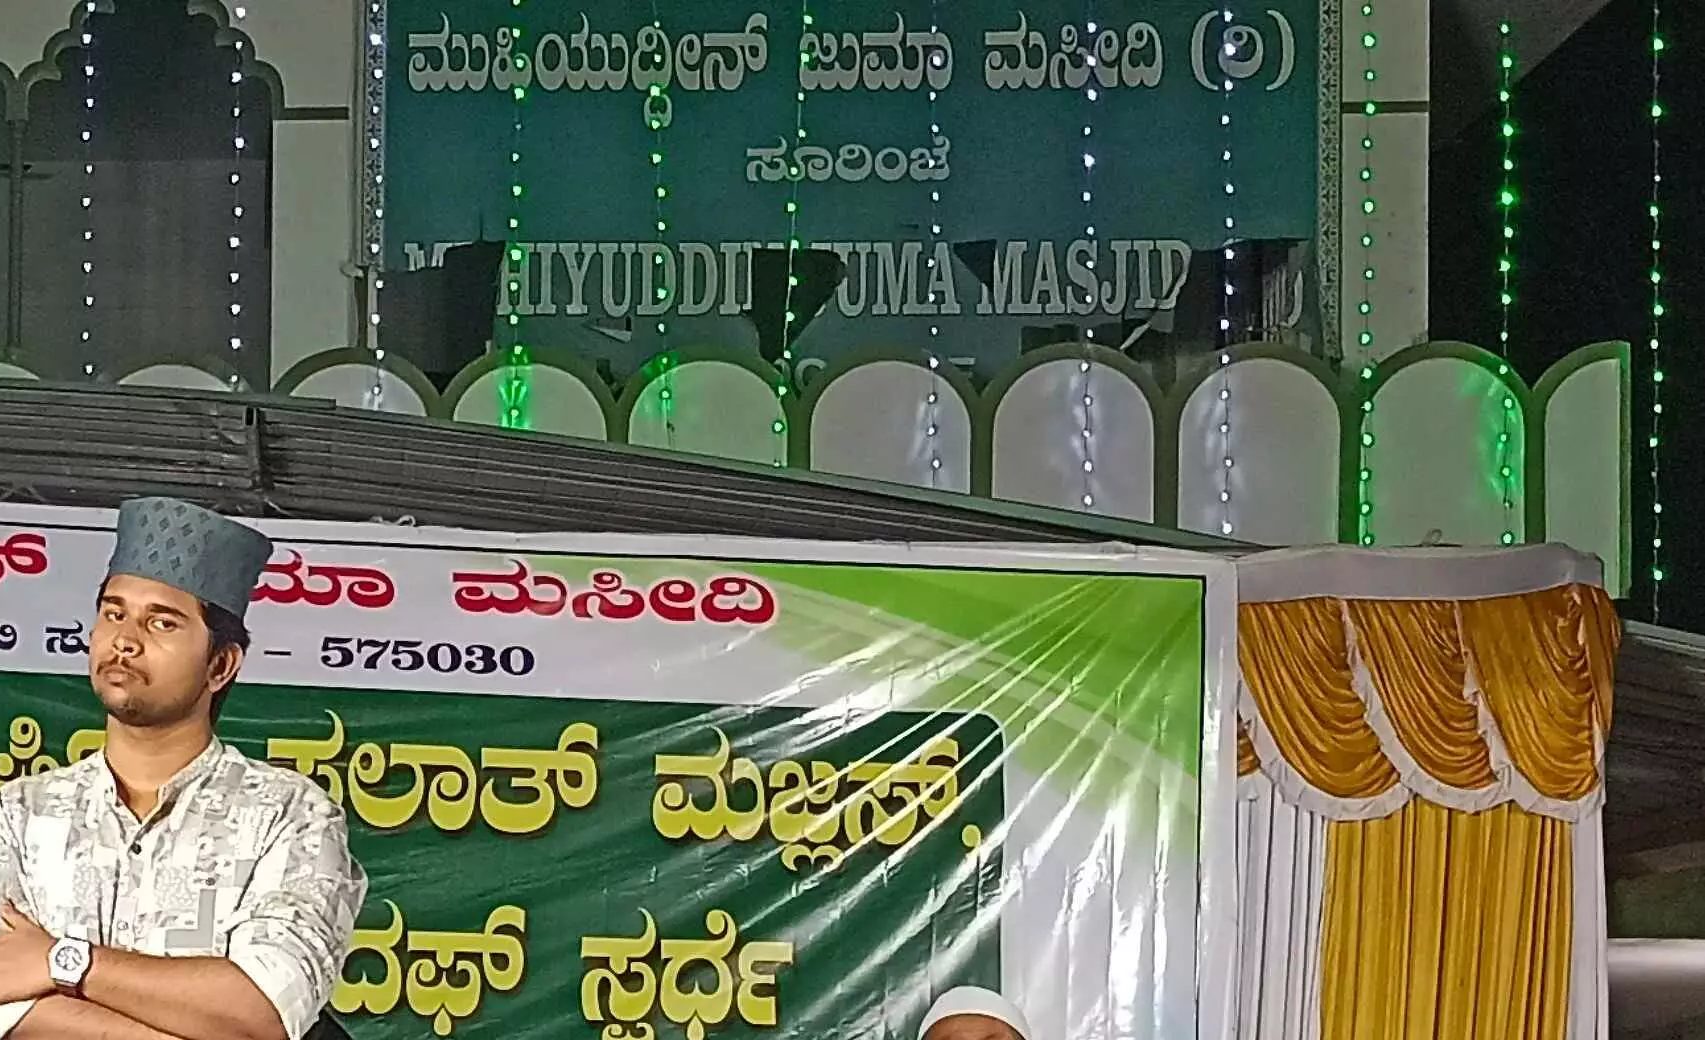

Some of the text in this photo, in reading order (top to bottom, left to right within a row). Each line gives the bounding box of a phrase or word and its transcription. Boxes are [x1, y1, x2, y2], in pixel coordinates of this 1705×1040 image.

[985, 10, 1163, 90] ಮಸೀದಿ
[810, 241, 961, 317] UMA
[453, 560, 775, 623] ಮಸೀದಿ
[320, 636, 535, 676] 575030
